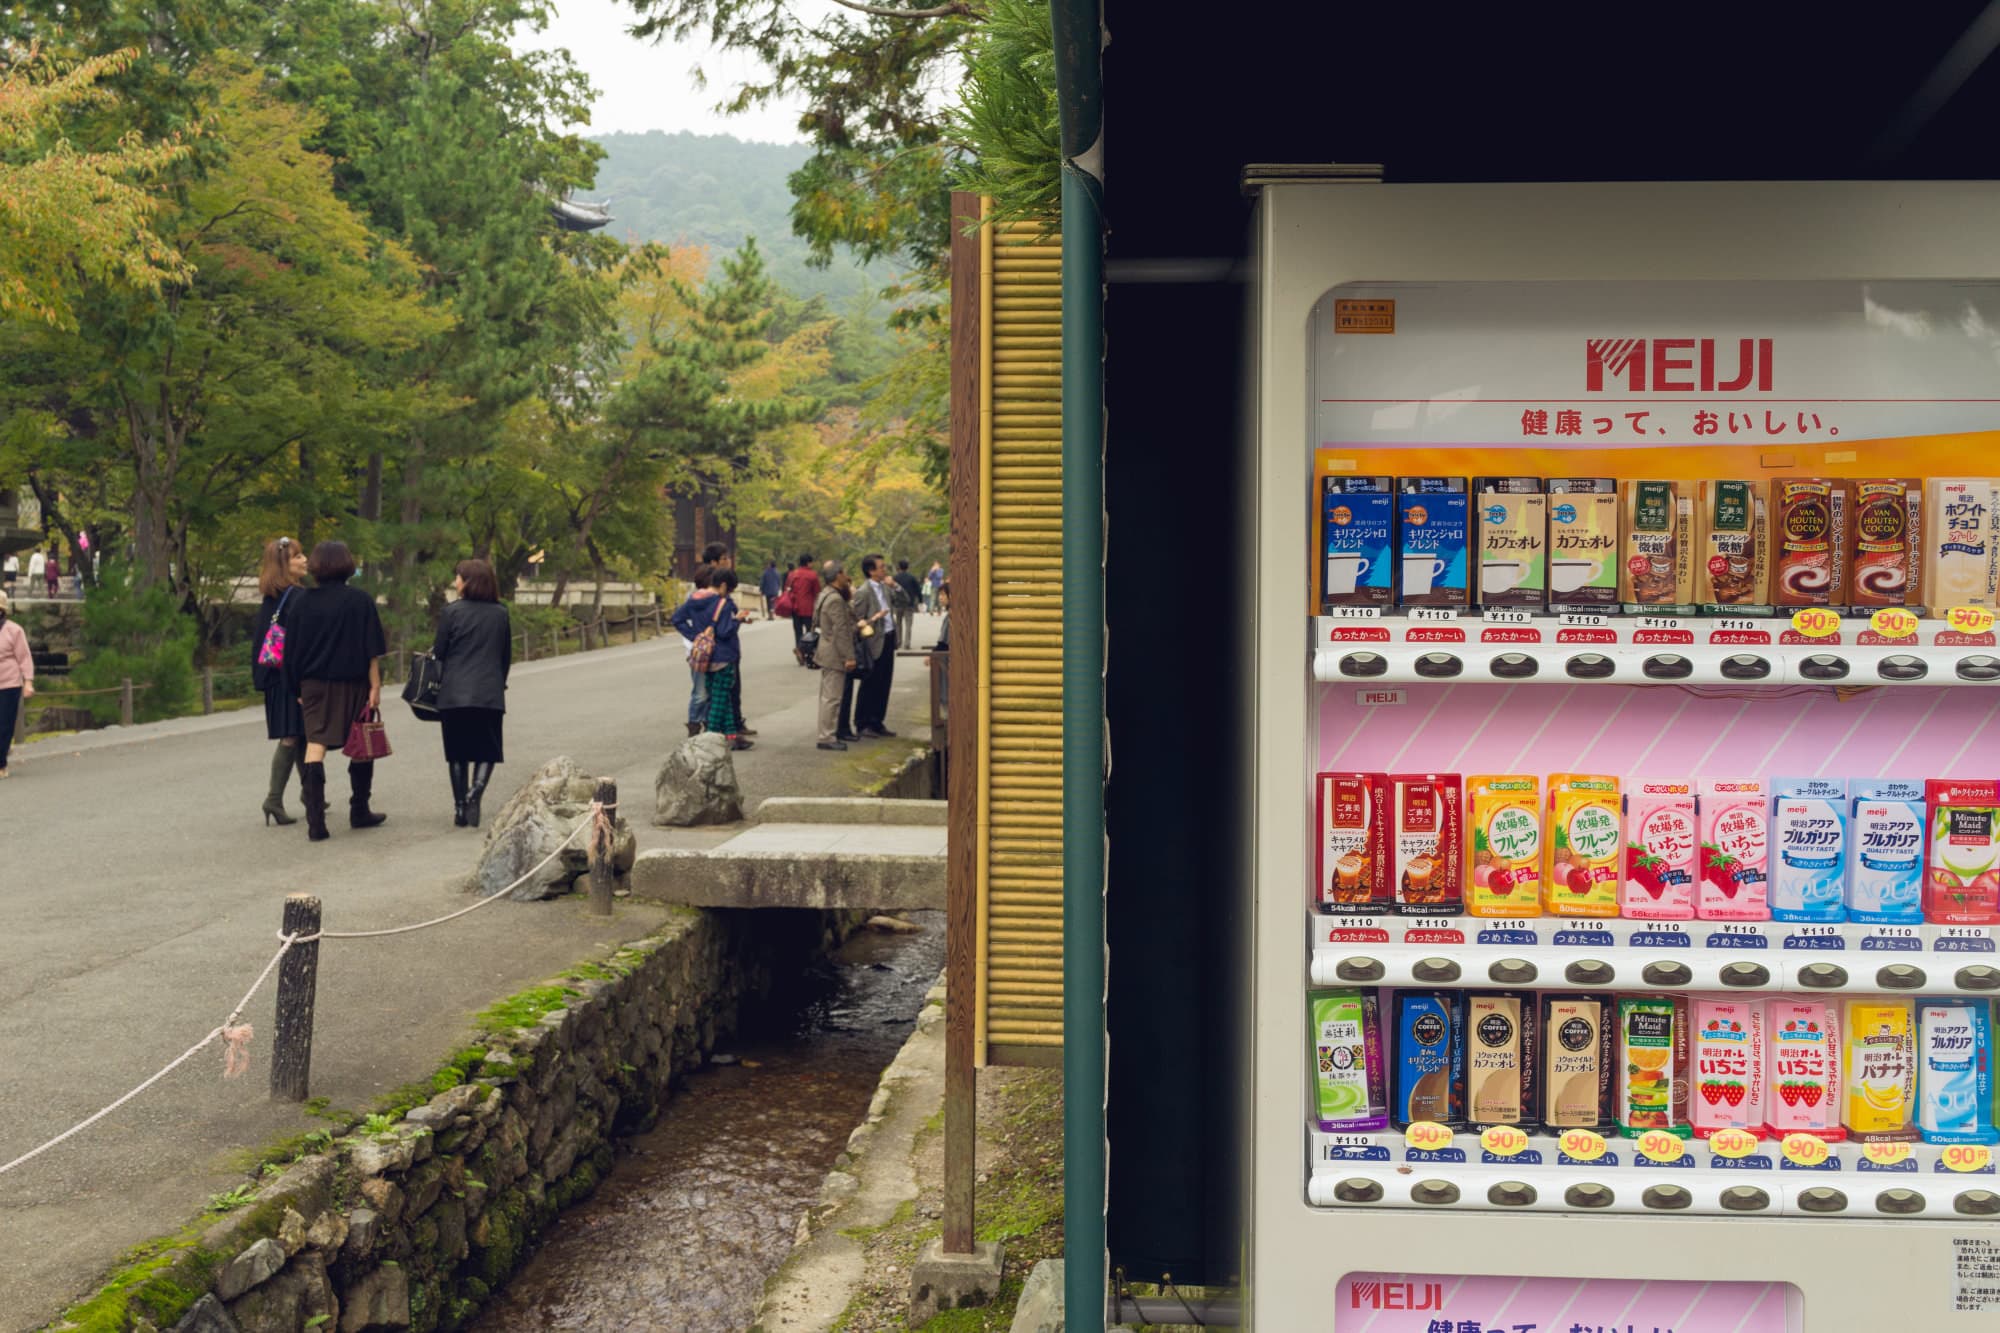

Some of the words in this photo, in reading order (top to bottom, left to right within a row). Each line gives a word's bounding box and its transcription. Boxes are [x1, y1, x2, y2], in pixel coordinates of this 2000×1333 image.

[1587, 338, 1773, 392] MEIJI
[1521, 409, 1839, 436] 健康って、おいしい。
[1946, 484, 1966, 492] meiji
[1945, 504, 1986, 516] ホワイト
[1720, 514, 1741, 522] カフェ
[1790, 516, 1823, 524] HOUTEN
[1948, 517, 1979, 529] チョコ
[1333, 529, 1387, 539] キリマンジャロ
[1408, 530, 1463, 540] キリマンジャロ
[1334, 539, 1364, 549] ブレンド
[1409, 540, 1440, 550] ブレンド
[1487, 536, 1541, 549] カフェ・オ・レ
[1556, 535, 1614, 549] カフェ・オ・レ
[1638, 542, 1665, 553] 微糖
[1718, 542, 1742, 553] 微糖
[1341, 609, 1373, 617] ¥110
[1417, 611, 1450, 619] ¥110
[1491, 613, 1524, 621] ¥110
[1954, 608, 1993, 626] 90円
[1567, 616, 1600, 624] ¥110
[1644, 618, 1677, 627] ¥110
[1720, 620, 1753, 629] ¥110
[1799, 612, 1838, 630] 90円
[1877, 613, 1916, 631] 90円
[1333, 631, 1387, 640] あったか～い
[1408, 631, 1463, 640] あったか～い
[1484, 632, 1538, 640] あったか～い
[1560, 632, 1614, 641] あったか～い
[1636, 633, 1691, 643] あったか～い
[1713, 634, 1768, 644] あったか～い
[1366, 693, 1397, 703] MEIJI
[1336, 804, 1361, 812] ご褒美
[1407, 808, 1432, 817] ご褒美
[1787, 806, 1808, 814] meiji
[1867, 808, 1888, 817] meiji
[1955, 813, 1987, 822] Minute
[1495, 816, 1529, 832] 牧場発
[1576, 815, 1610, 831] 牧場発
[1648, 818, 1685, 834] 牧場発
[1720, 817, 1757, 833] 牧場発
[1790, 819, 1834, 829] 明治アクア
[1870, 822, 1914, 832] 明治アクア
[1331, 836, 1366, 844] キャラメル
[1494, 830, 1537, 853] フルーツ
[1575, 830, 1619, 851] フルーツ
[1721, 832, 1764, 852] いちご
[1784, 830, 1840, 845] ブルガリア
[1862, 832, 1920, 848] ブルガリア
[1400, 839, 1436, 848] キャラメル
[1648, 833, 1693, 853] いちご
[1331, 844, 1365, 853] マキアート
[1401, 847, 1436, 856] マキアート
[1341, 918, 1373, 926] ¥110
[1416, 919, 1448, 927] ¥110
[1493, 920, 1525, 929] ¥110
[1571, 921, 1603, 930] ¥110
[1647, 923, 1680, 931] ¥110
[1724, 925, 1757, 934] ¥110
[1802, 927, 1835, 936] ¥110
[1879, 928, 1912, 936] ¥110
[1948, 928, 1982, 936] ¥110
[1332, 931, 1386, 941] あったか～い
[1407, 933, 1462, 942] あったか～い
[1481, 934, 1535, 943] つめた～い
[1556, 935, 1611, 944] つめた～い
[1633, 936, 1688, 945] つめた～い
[1710, 937, 1765, 946] つめた～い
[1787, 939, 1842, 947] つめた～い
[1864, 940, 1919, 949] つめた～い
[1937, 941, 1992, 950] つめた～い
[1635, 1015, 1667, 1023] Minute
[1638, 1023, 1662, 1031] Maid
[1931, 1035, 1972, 1049] ブルガリア
[1522, 1007, 1533, 1090] まろやかなミルクのコク
[1600, 1008, 1612, 1092] まろやかなミルクのコク
[1408, 1056, 1449, 1064] キリマンジャロ
[1473, 1059, 1516, 1069] カフェ・オ・レ
[1416, 1064, 1440, 1072] ブレンド
[1554, 1063, 1595, 1073] カフェ・オ・レ
[1700, 1059, 1747, 1075] いちご
[1778, 1059, 1824, 1076] いちご
[1860, 1063, 1905, 1079] バナナ
[1413, 1126, 1450, 1143] 90円
[1488, 1131, 1526, 1148] 90円
[1336, 1136, 1368, 1144] ¥110
[1567, 1134, 1605, 1153] 90円
[1644, 1135, 1682, 1154] 90円
[1717, 1134, 1755, 1151] 90円
[1789, 1139, 1827, 1158] 90円
[1870, 1142, 1908, 1157] 90円
[1409, 1151, 1463, 1160] つめた～い
[1949, 1147, 1988, 1165] 90円
[1713, 1158, 1769, 1168] つめた～い
[1351, 1281, 1442, 1310] MEIJI
